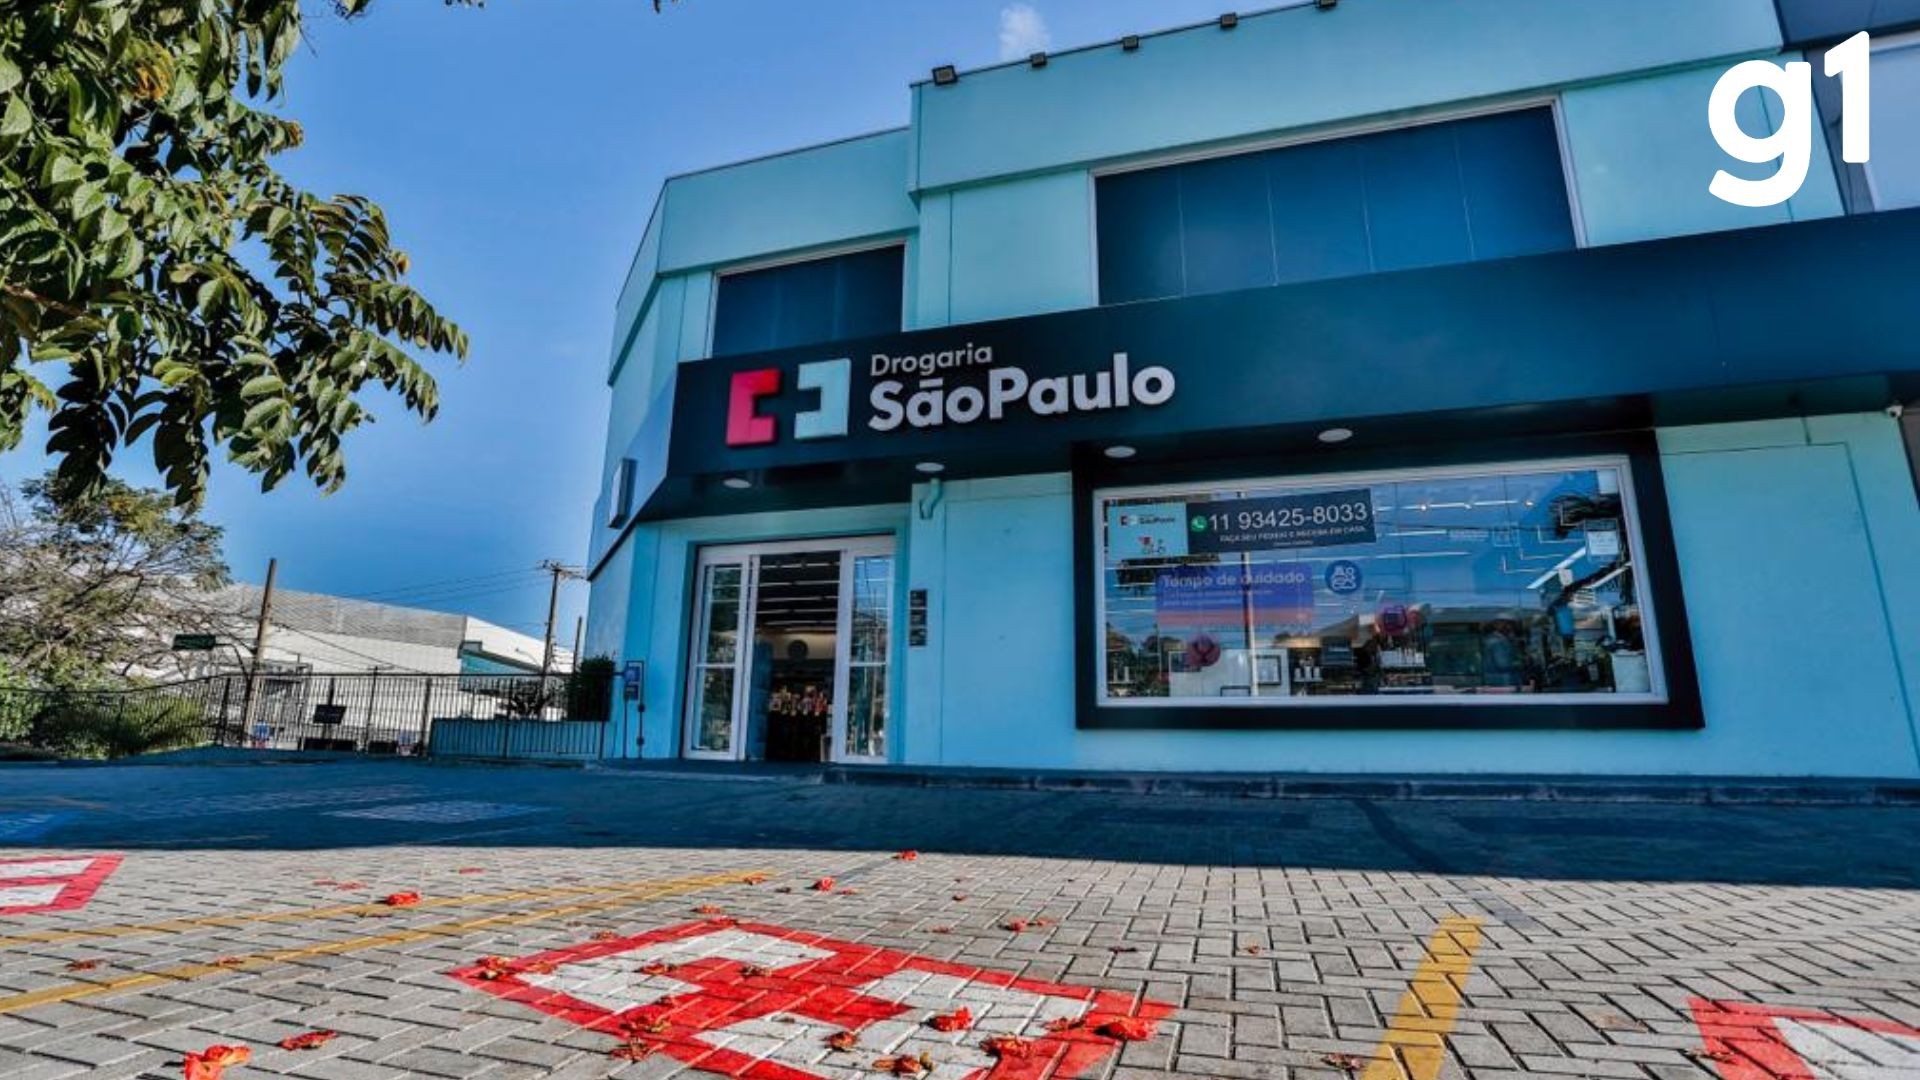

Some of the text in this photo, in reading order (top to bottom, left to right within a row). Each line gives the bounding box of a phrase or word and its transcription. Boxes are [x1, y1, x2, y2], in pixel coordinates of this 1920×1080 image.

[870, 342, 993, 376] Drogaria
[868, 352, 1176, 432] SãoPaulo
[1209, 502, 1368, 531] 11 93425-8033
[1163, 571, 1305, 589] Tempo de cuidado
